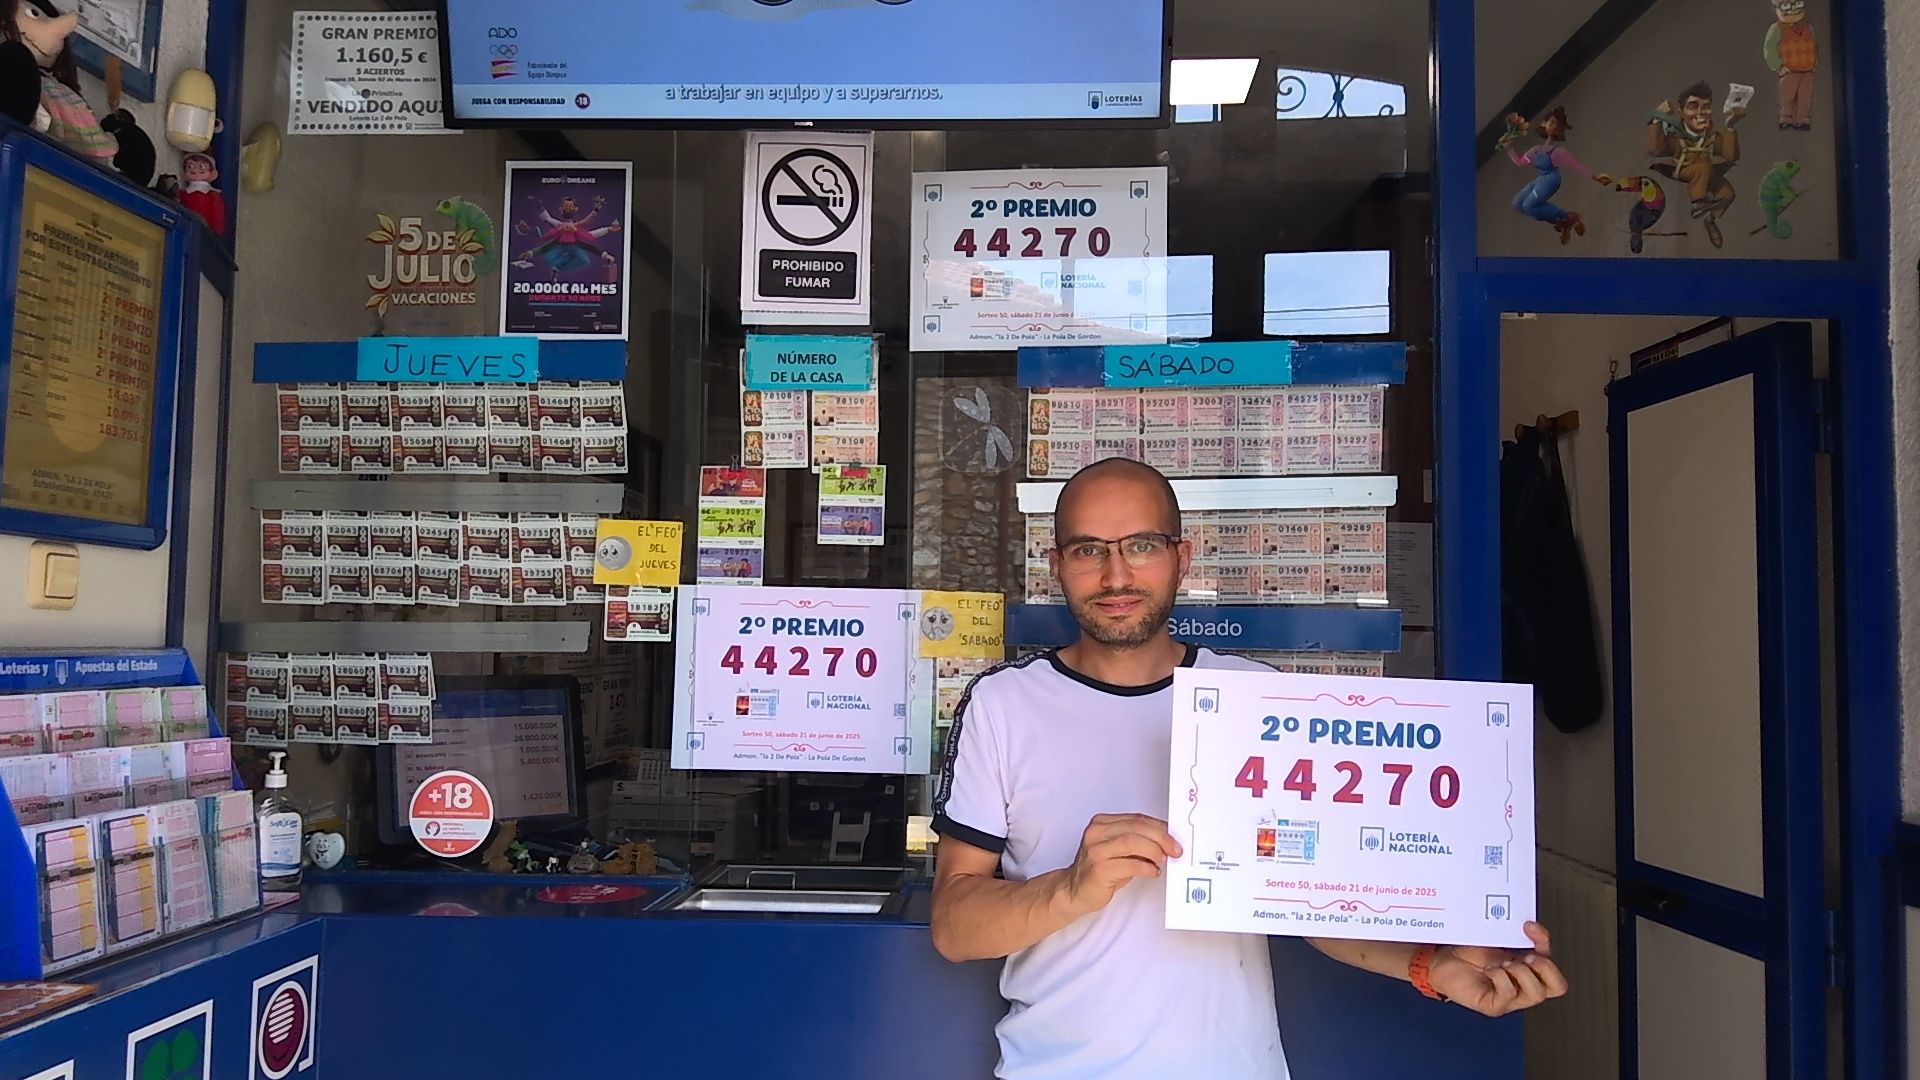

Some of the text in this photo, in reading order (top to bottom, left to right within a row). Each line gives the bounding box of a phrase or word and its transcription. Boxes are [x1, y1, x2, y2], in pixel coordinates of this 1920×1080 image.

[322, 28, 437, 40] GRAN PREMIO
[336, 48, 427, 66] 1.160,5 €
[363, 68, 405, 76] ACIERTOS
[665, 84, 944, 104] a trabajar en equipo y a superarnos.
[308, 100, 393, 114] VENDIDO
[1004, 198, 1097, 218] PREMIO
[399, 217, 457, 252] 5 DE
[367, 244, 478, 290] JULIO
[772, 259, 844, 272] PROHIBIDO
[513, 282, 617, 295] 20.000€ AL MES
[785, 276, 831, 288] FUMAR
[391, 292, 477, 305] VACACIONES
[384, 344, 527, 379] JUEVES
[777, 351, 837, 365] NÚMERO
[1119, 352, 1235, 378] SÁBADO
[770, 371, 844, 384] DE LA CASA
[638, 526, 650, 537] EL
[648, 543, 667, 553] DEL
[640, 559, 677, 570] JUEVES
[957, 599, 971, 609] EL
[738, 616, 865, 637] 2º PREMIO
[972, 616, 992, 626] DEL
[1167, 617, 1243, 637] Sábado
[0, 659, 158, 677] Loterías y Apuestas del Estado
[827, 693, 863, 703] LOTERÍA
[827, 702, 872, 711] NACIONAL
[1260, 715, 1441, 749] 2º PREMIO
[428, 783, 473, 809] +18
[1389, 830, 1440, 844] LOTERÍA
[1388, 841, 1453, 856] NACIONAL
[1266, 879, 1437, 897] Sorteo 50, sábado 21 de junio de 2025
[1253, 910, 1289, 920] Admon.
[1291, 911, 1304, 921] "la
[1306, 913, 1312, 921] 2
[1314, 913, 1327, 922] De
[1328, 914, 1353, 924] Pola"
[1361, 915, 1372, 925] La
[1374, 917, 1394, 926] Pola
[1395, 918, 1408, 927] De
[1410, 919, 1445, 929] Gordon
